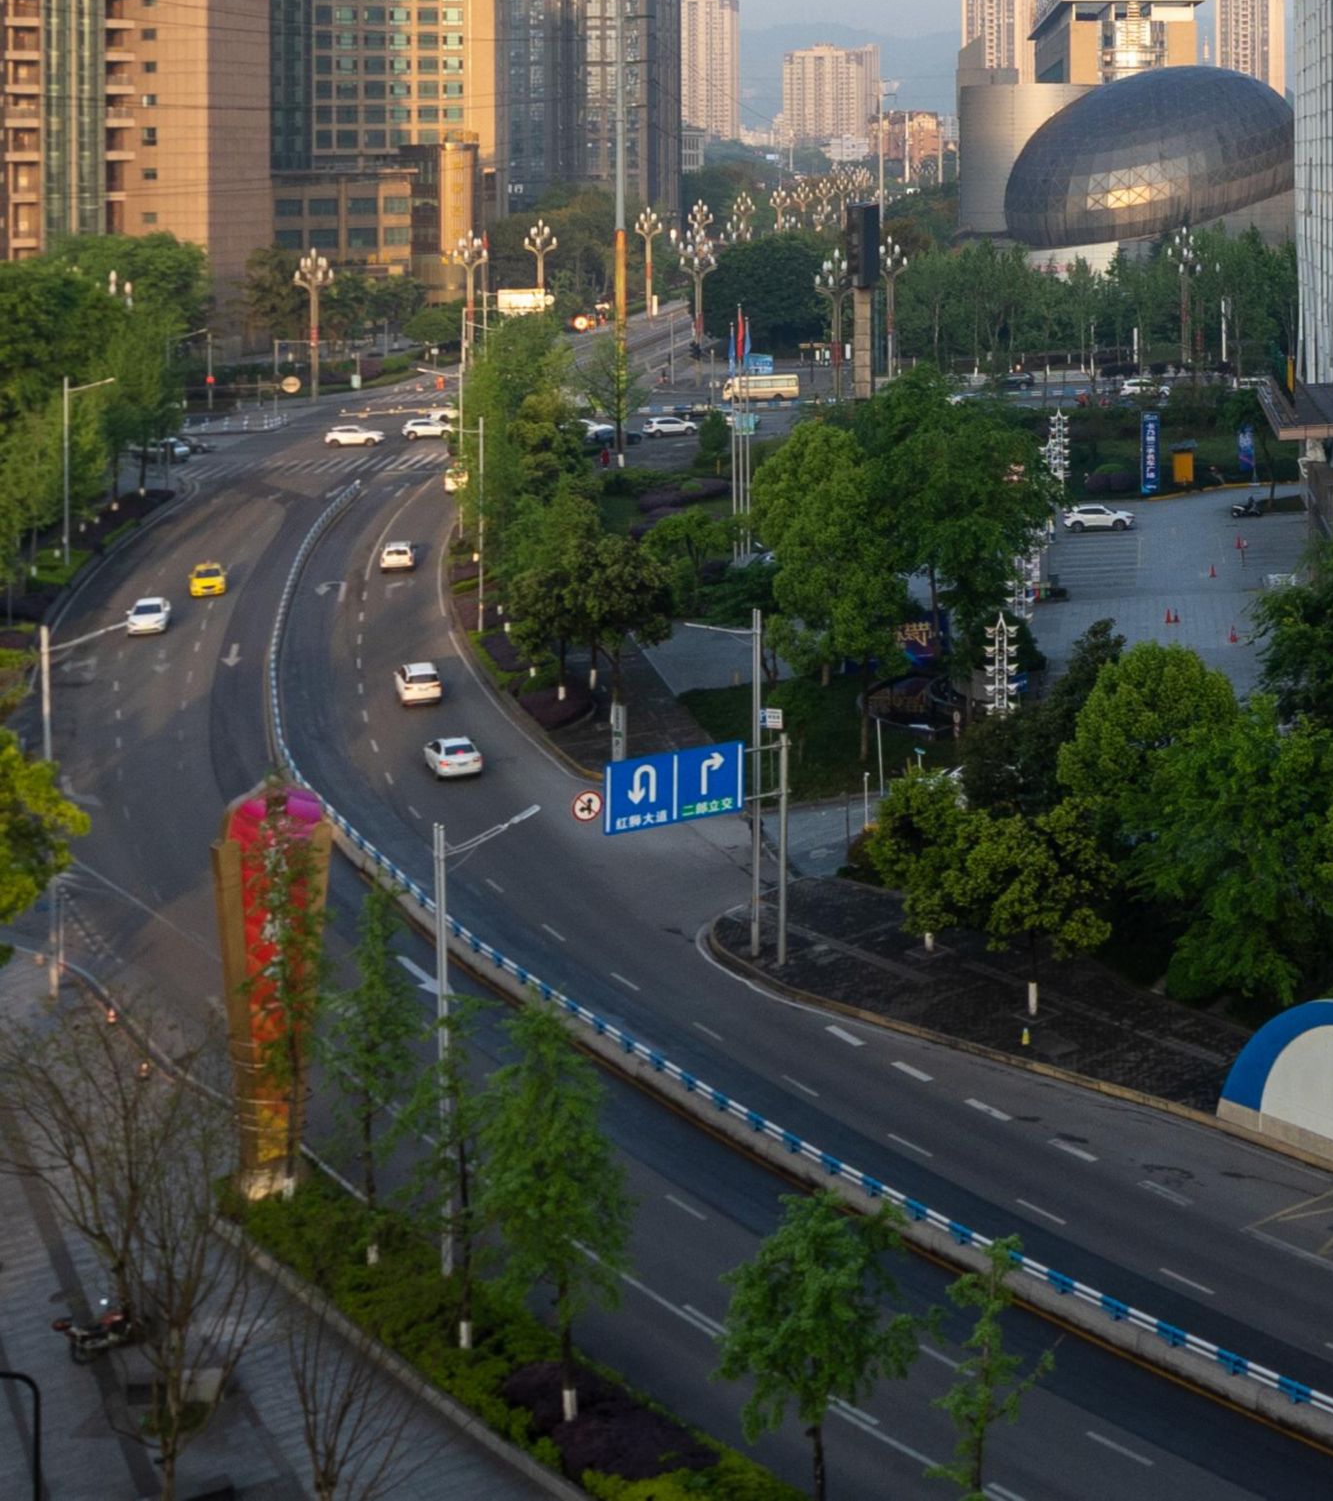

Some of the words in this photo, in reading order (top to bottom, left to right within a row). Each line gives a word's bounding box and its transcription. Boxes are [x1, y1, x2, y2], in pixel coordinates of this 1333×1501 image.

[682, 797, 734, 817] 二郎立交
[615, 809, 668, 830] 红狮大道
